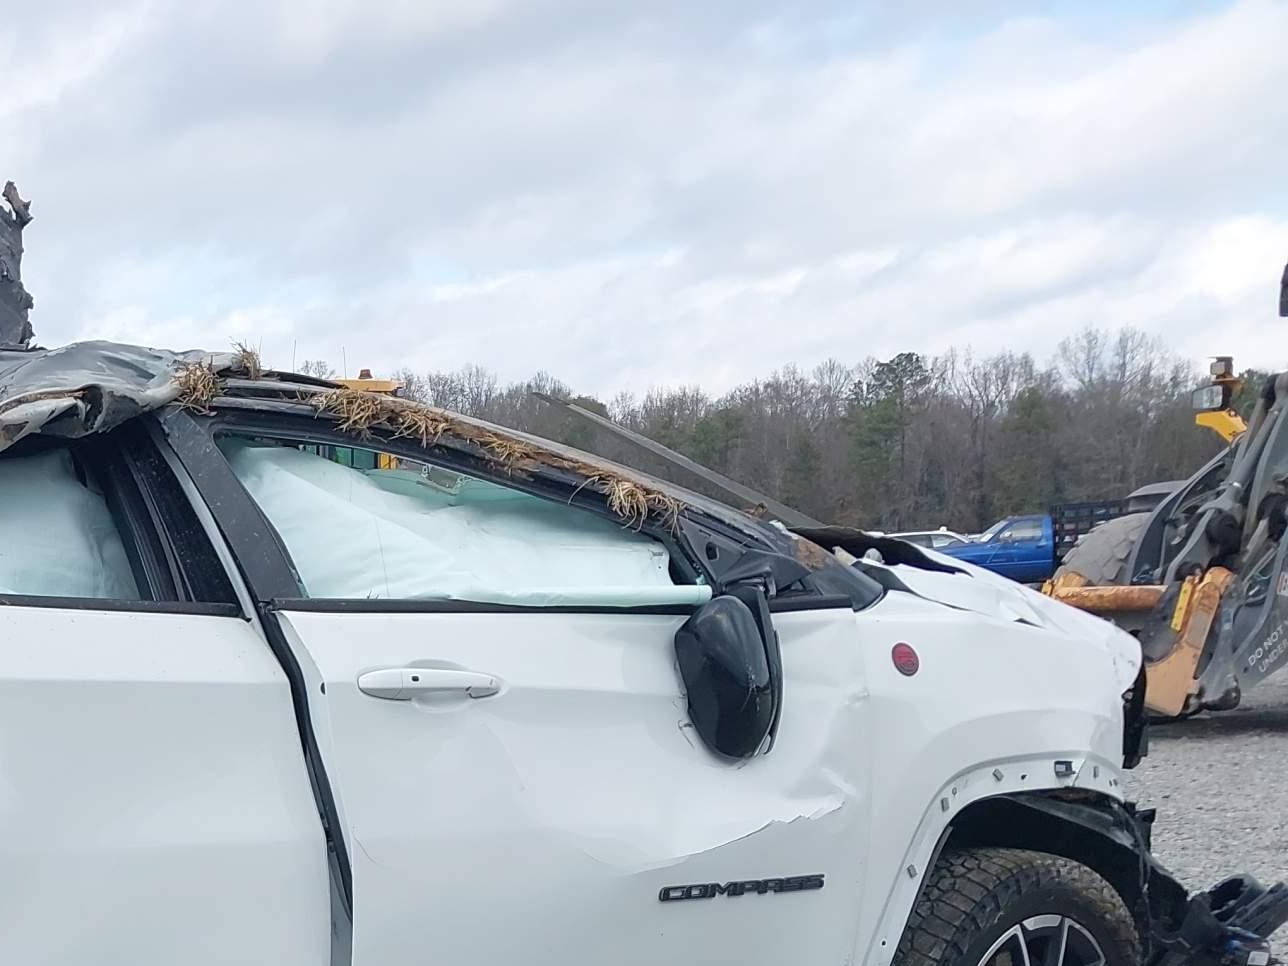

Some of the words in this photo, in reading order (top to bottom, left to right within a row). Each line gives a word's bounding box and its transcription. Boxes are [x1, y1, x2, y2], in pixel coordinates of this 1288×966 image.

[1248, 648, 1263, 666] DO
[1264, 625, 1284, 650] NOT
[659, 873, 825, 902] COMPASS
